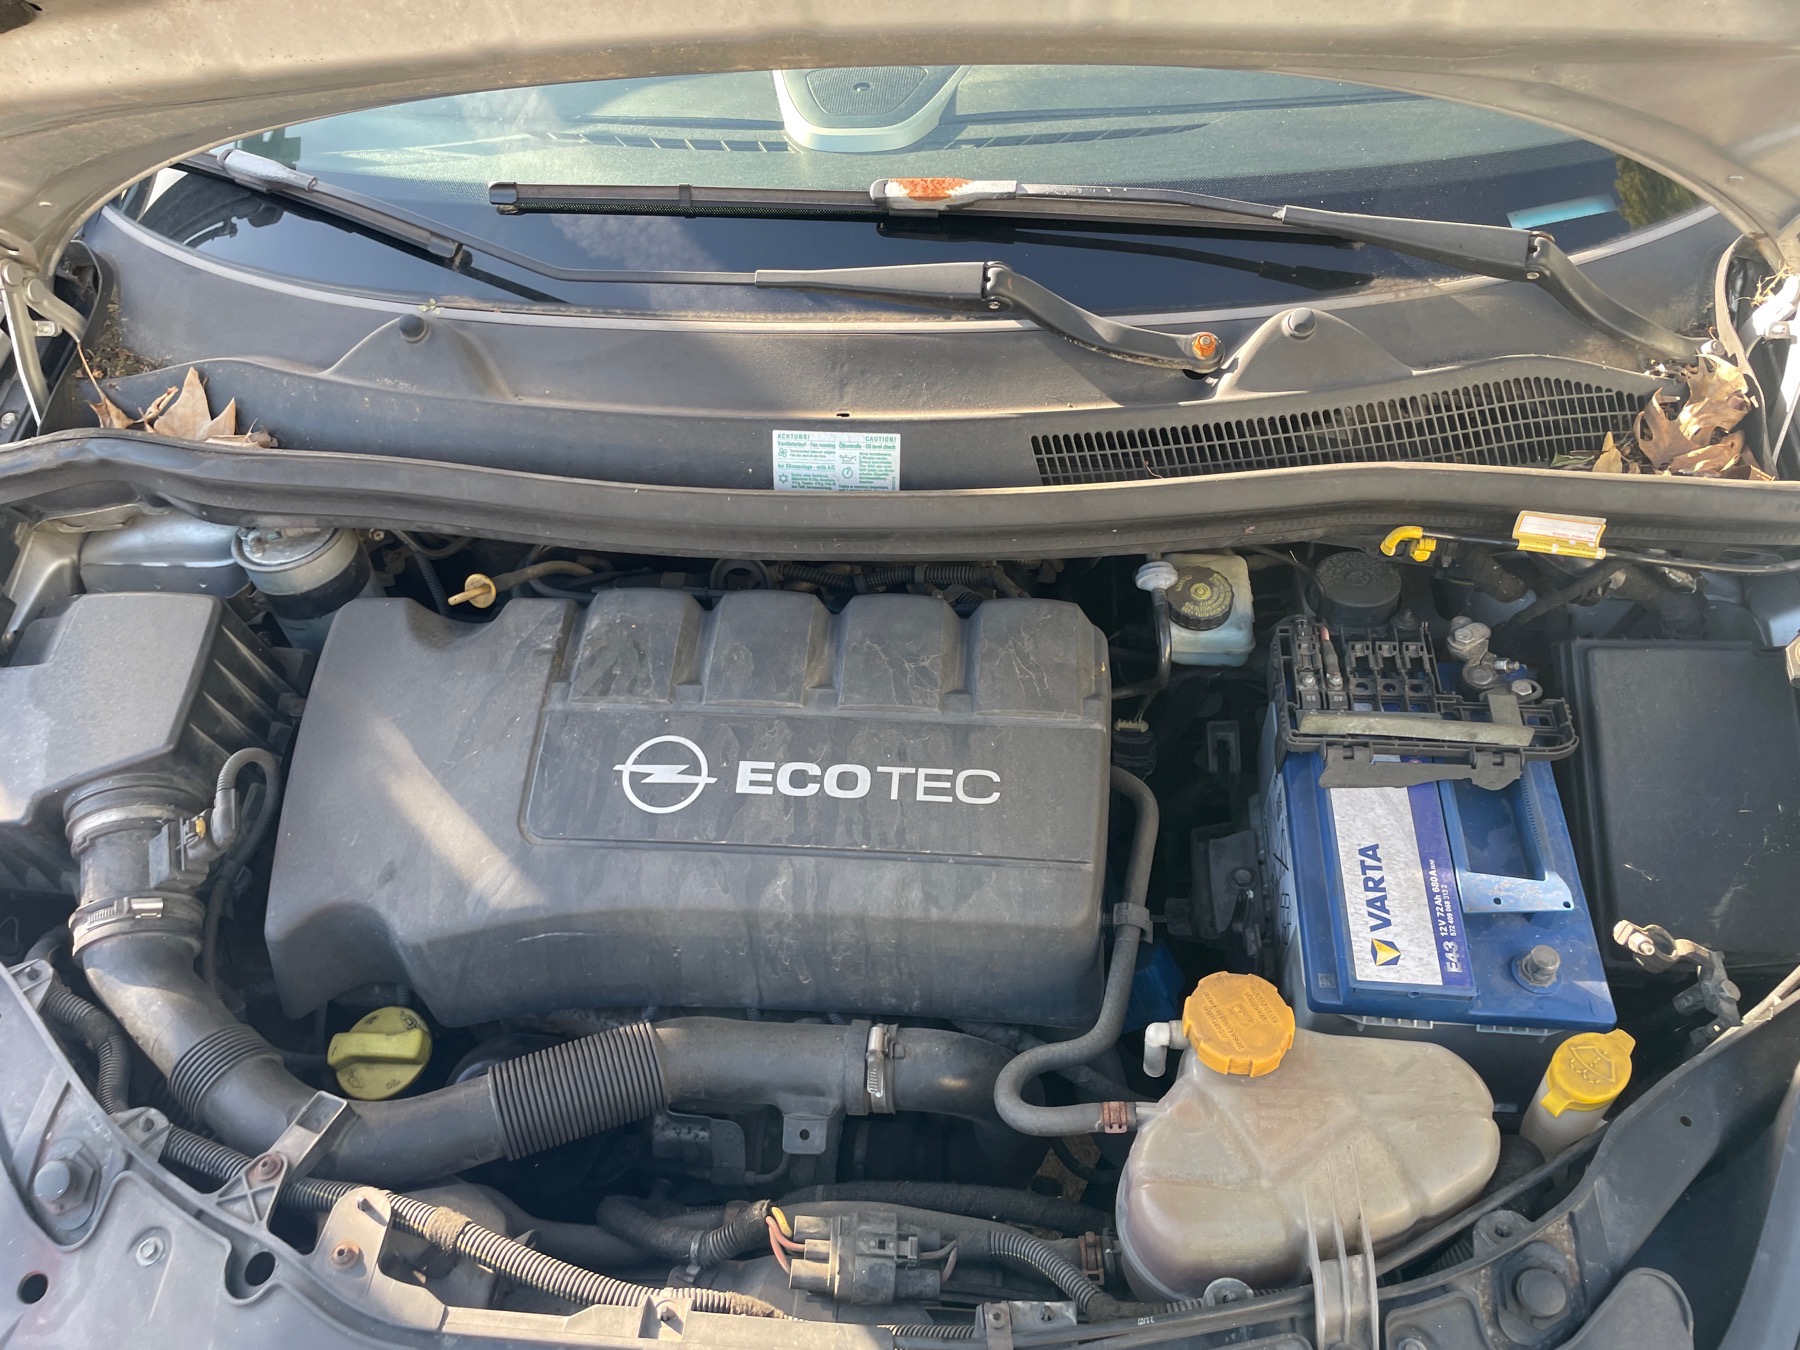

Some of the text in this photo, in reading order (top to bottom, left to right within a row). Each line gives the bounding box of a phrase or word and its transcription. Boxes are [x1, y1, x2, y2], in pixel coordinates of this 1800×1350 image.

[735, 760, 1001, 805] ECOTEC
[1358, 843, 1392, 932] VARTA
[1434, 895, 1444, 917] 72Ah
[1438, 919, 1448, 937] 12V
[1443, 941, 1462, 972] E43
